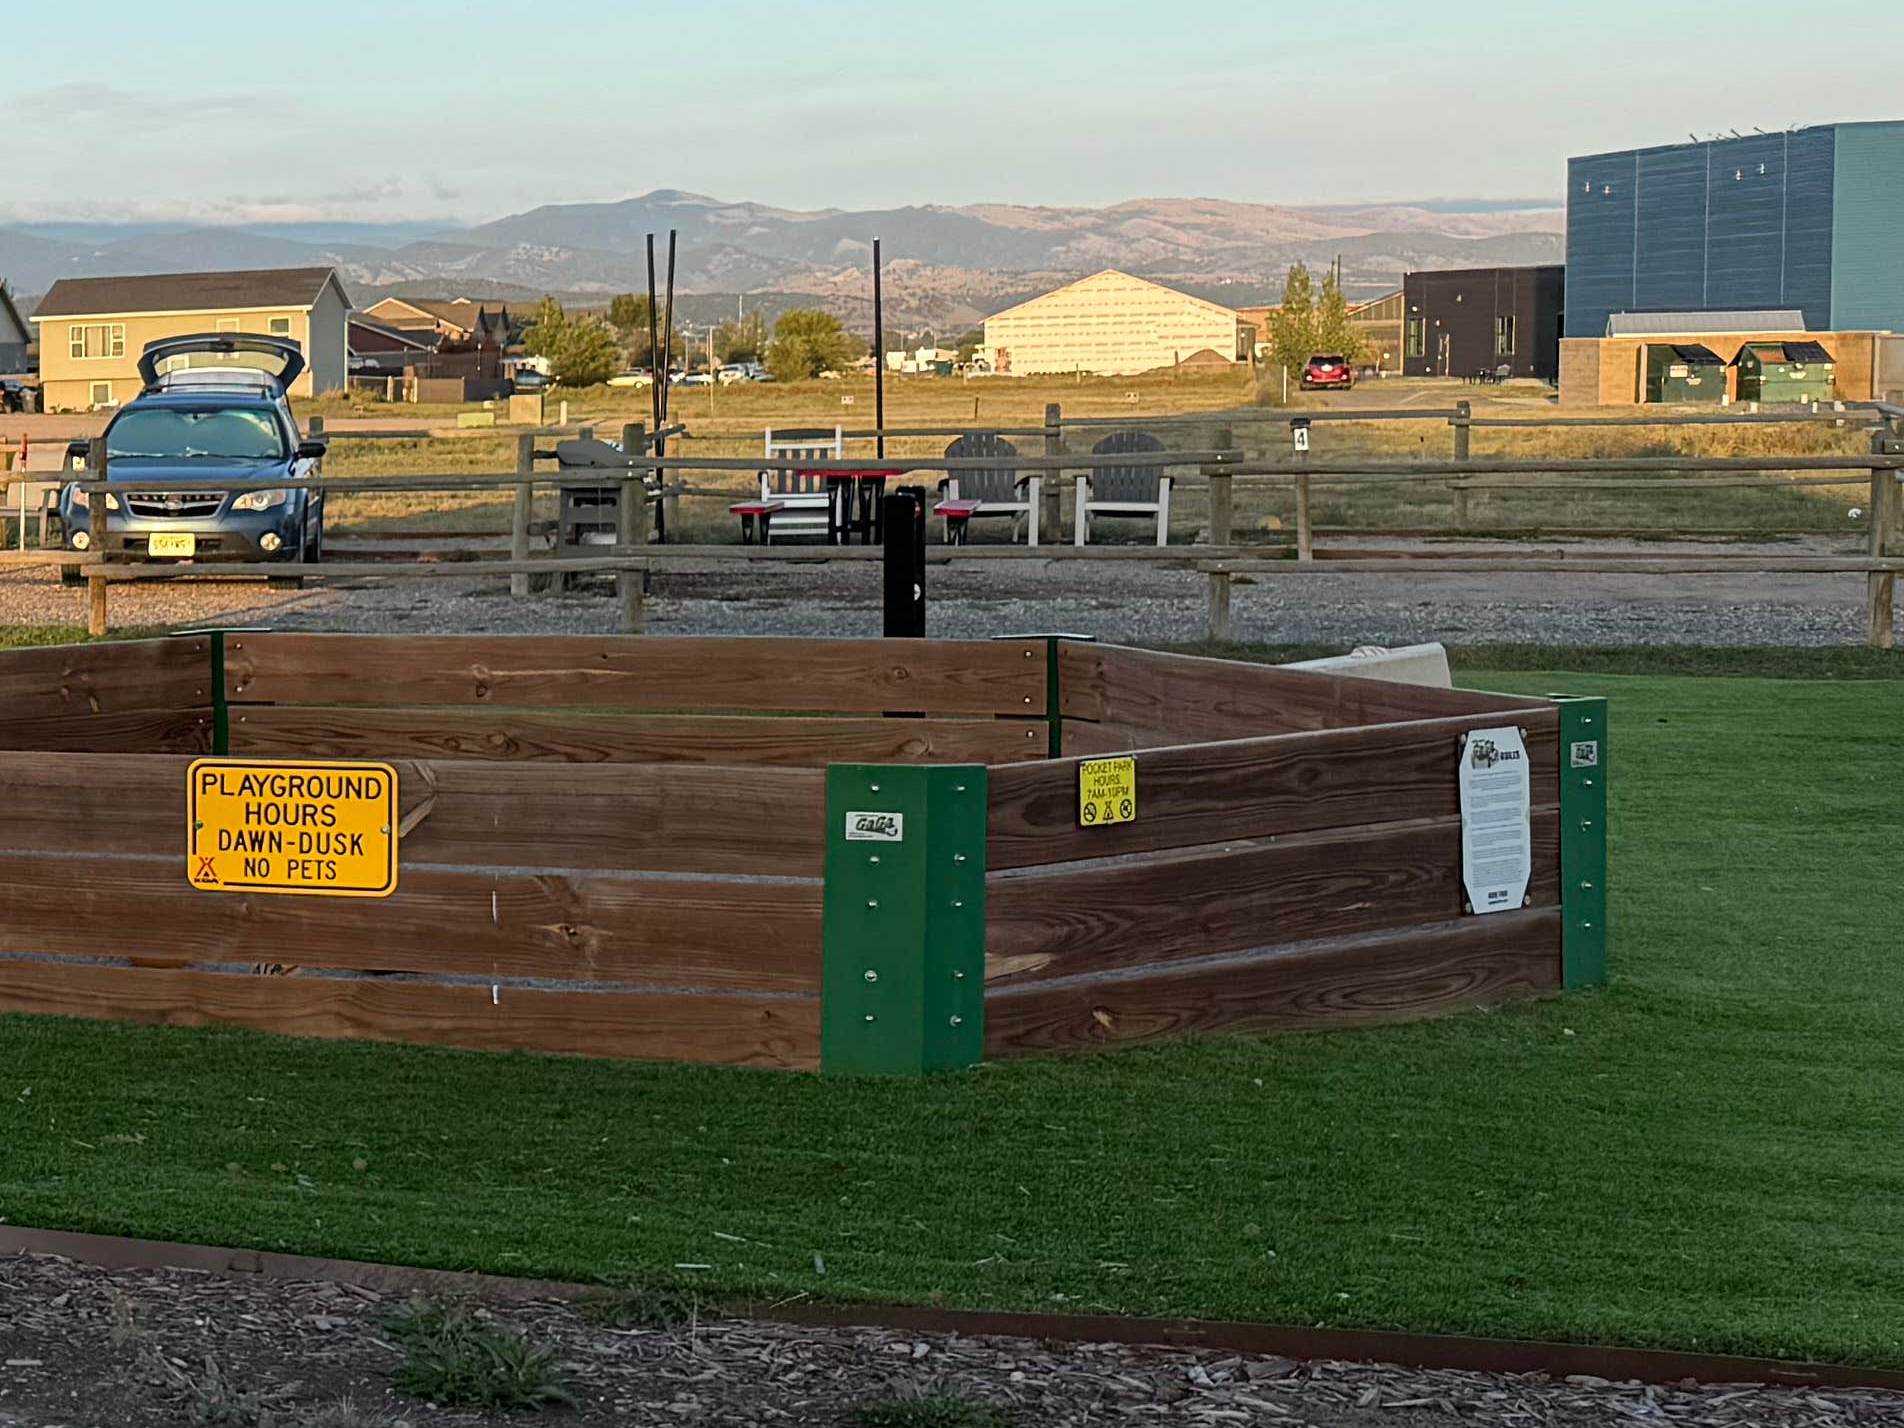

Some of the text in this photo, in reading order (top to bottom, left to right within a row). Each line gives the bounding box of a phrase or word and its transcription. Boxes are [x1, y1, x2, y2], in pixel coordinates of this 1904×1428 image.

[1296, 431, 1305, 446] 4
[1082, 760, 1132, 775] POCKET PARK
[201, 773, 382, 800] PLAYGROUND
[1093, 773, 1121, 786] HOURS
[245, 802, 337, 828] HOURS
[218, 829, 364, 857] DAWN-DUSK
[244, 857, 270, 878] NO
[287, 859, 337, 881] PETS
